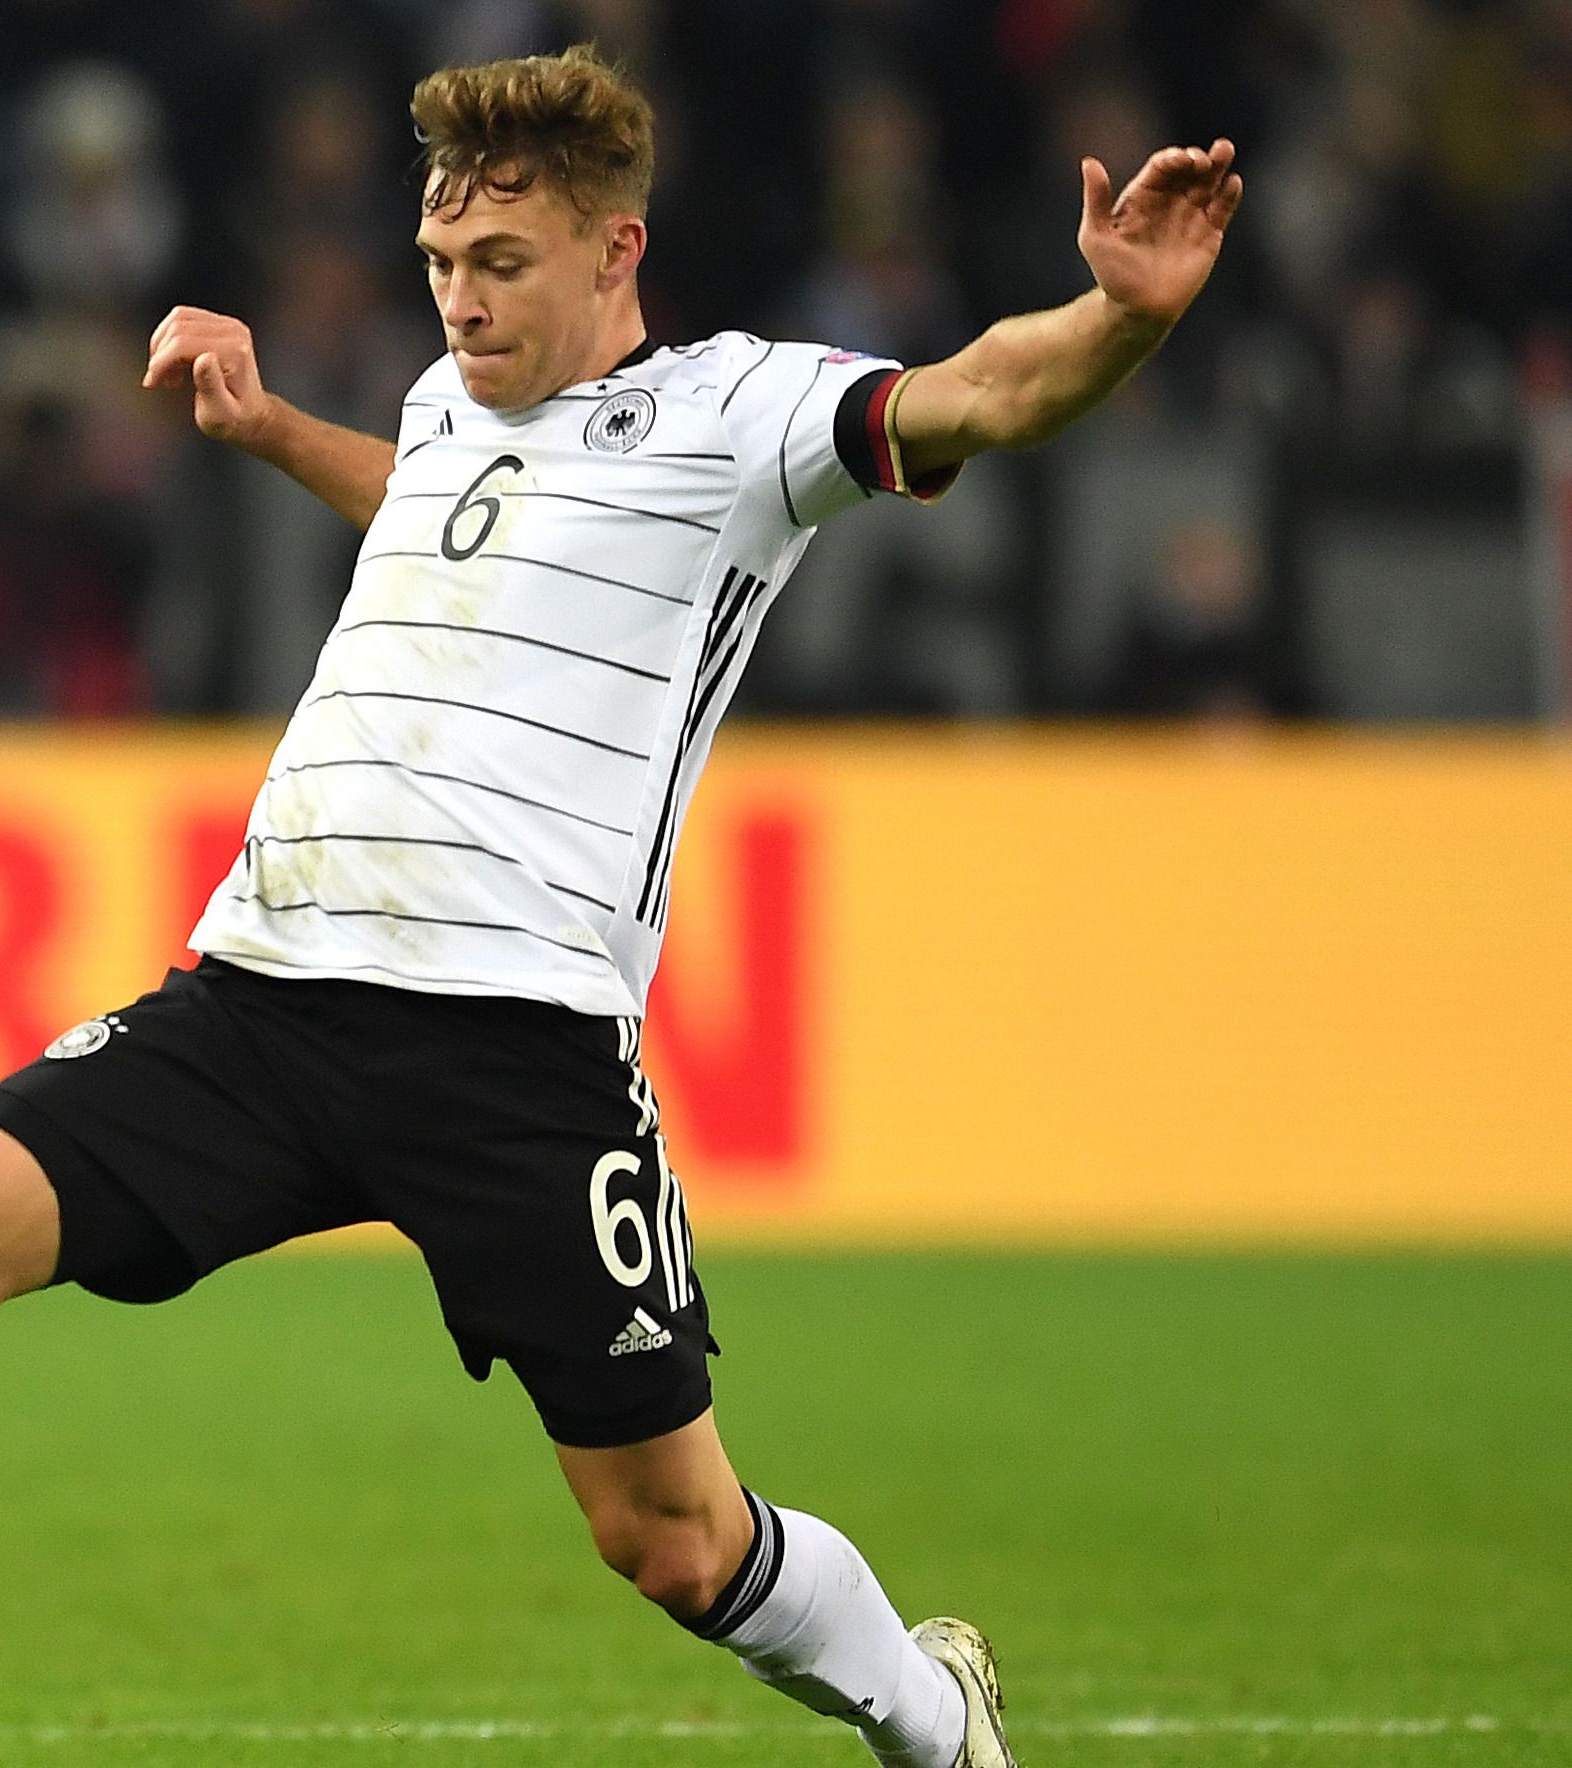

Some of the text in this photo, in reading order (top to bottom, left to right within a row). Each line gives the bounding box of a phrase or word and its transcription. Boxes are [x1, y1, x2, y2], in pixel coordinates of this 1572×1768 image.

[441, 454, 525, 561] 6
[589, 1150, 653, 1287] 6
[608, 1329, 673, 1357] adidas
